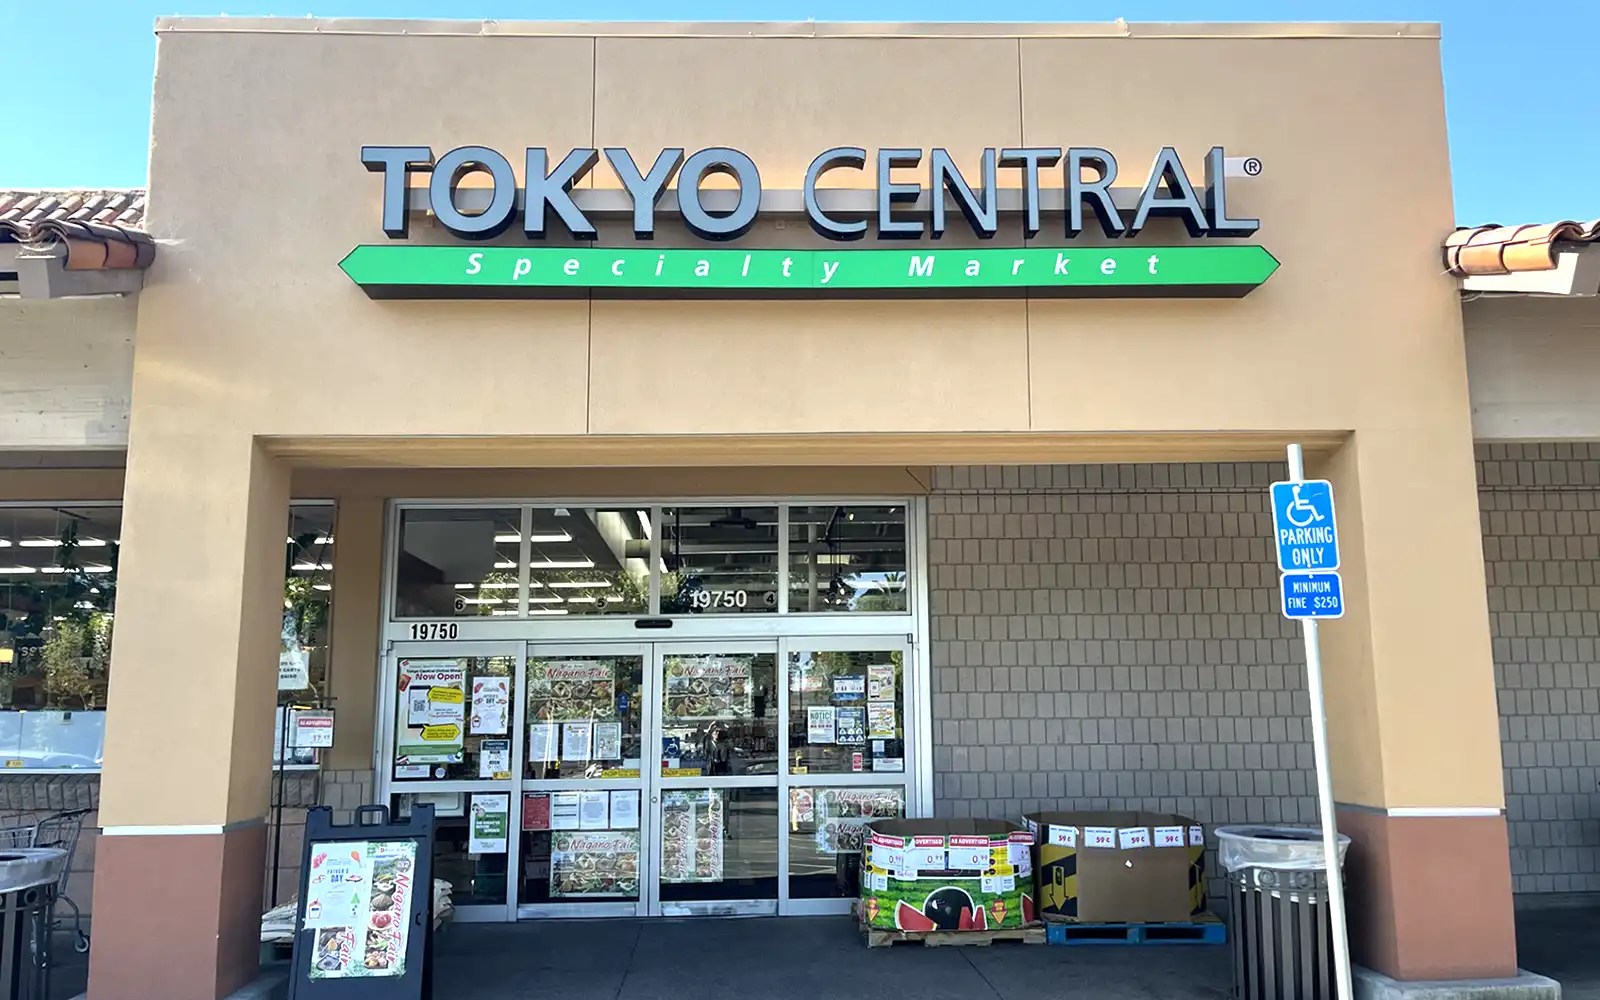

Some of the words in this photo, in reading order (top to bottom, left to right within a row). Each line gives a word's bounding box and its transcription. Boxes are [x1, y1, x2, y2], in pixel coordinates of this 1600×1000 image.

[361, 145, 763, 241] TOKYO
[803, 145, 1260, 241] CENTRAL
[466, 252, 840, 282] Specialty
[908, 252, 1160, 277] Market
[1280, 526, 1333, 546] PARKING
[1292, 547, 1325, 566] ONLY
[1292, 581, 1331, 594] MINIMUM
[455, 599, 464, 610] 6
[597, 597, 605, 608] 5
[689, 589, 748, 608] 19750
[766, 593, 775, 604] 4
[1287, 597, 1308, 609] FINE
[1313, 596, 1339, 609] $250
[411, 622, 458, 640] 19750
[415, 672, 437, 680] Now
[437, 672, 463, 681] Open!
[810, 711, 833, 720] NOTICE
[392, 873, 410, 928] Nagano
